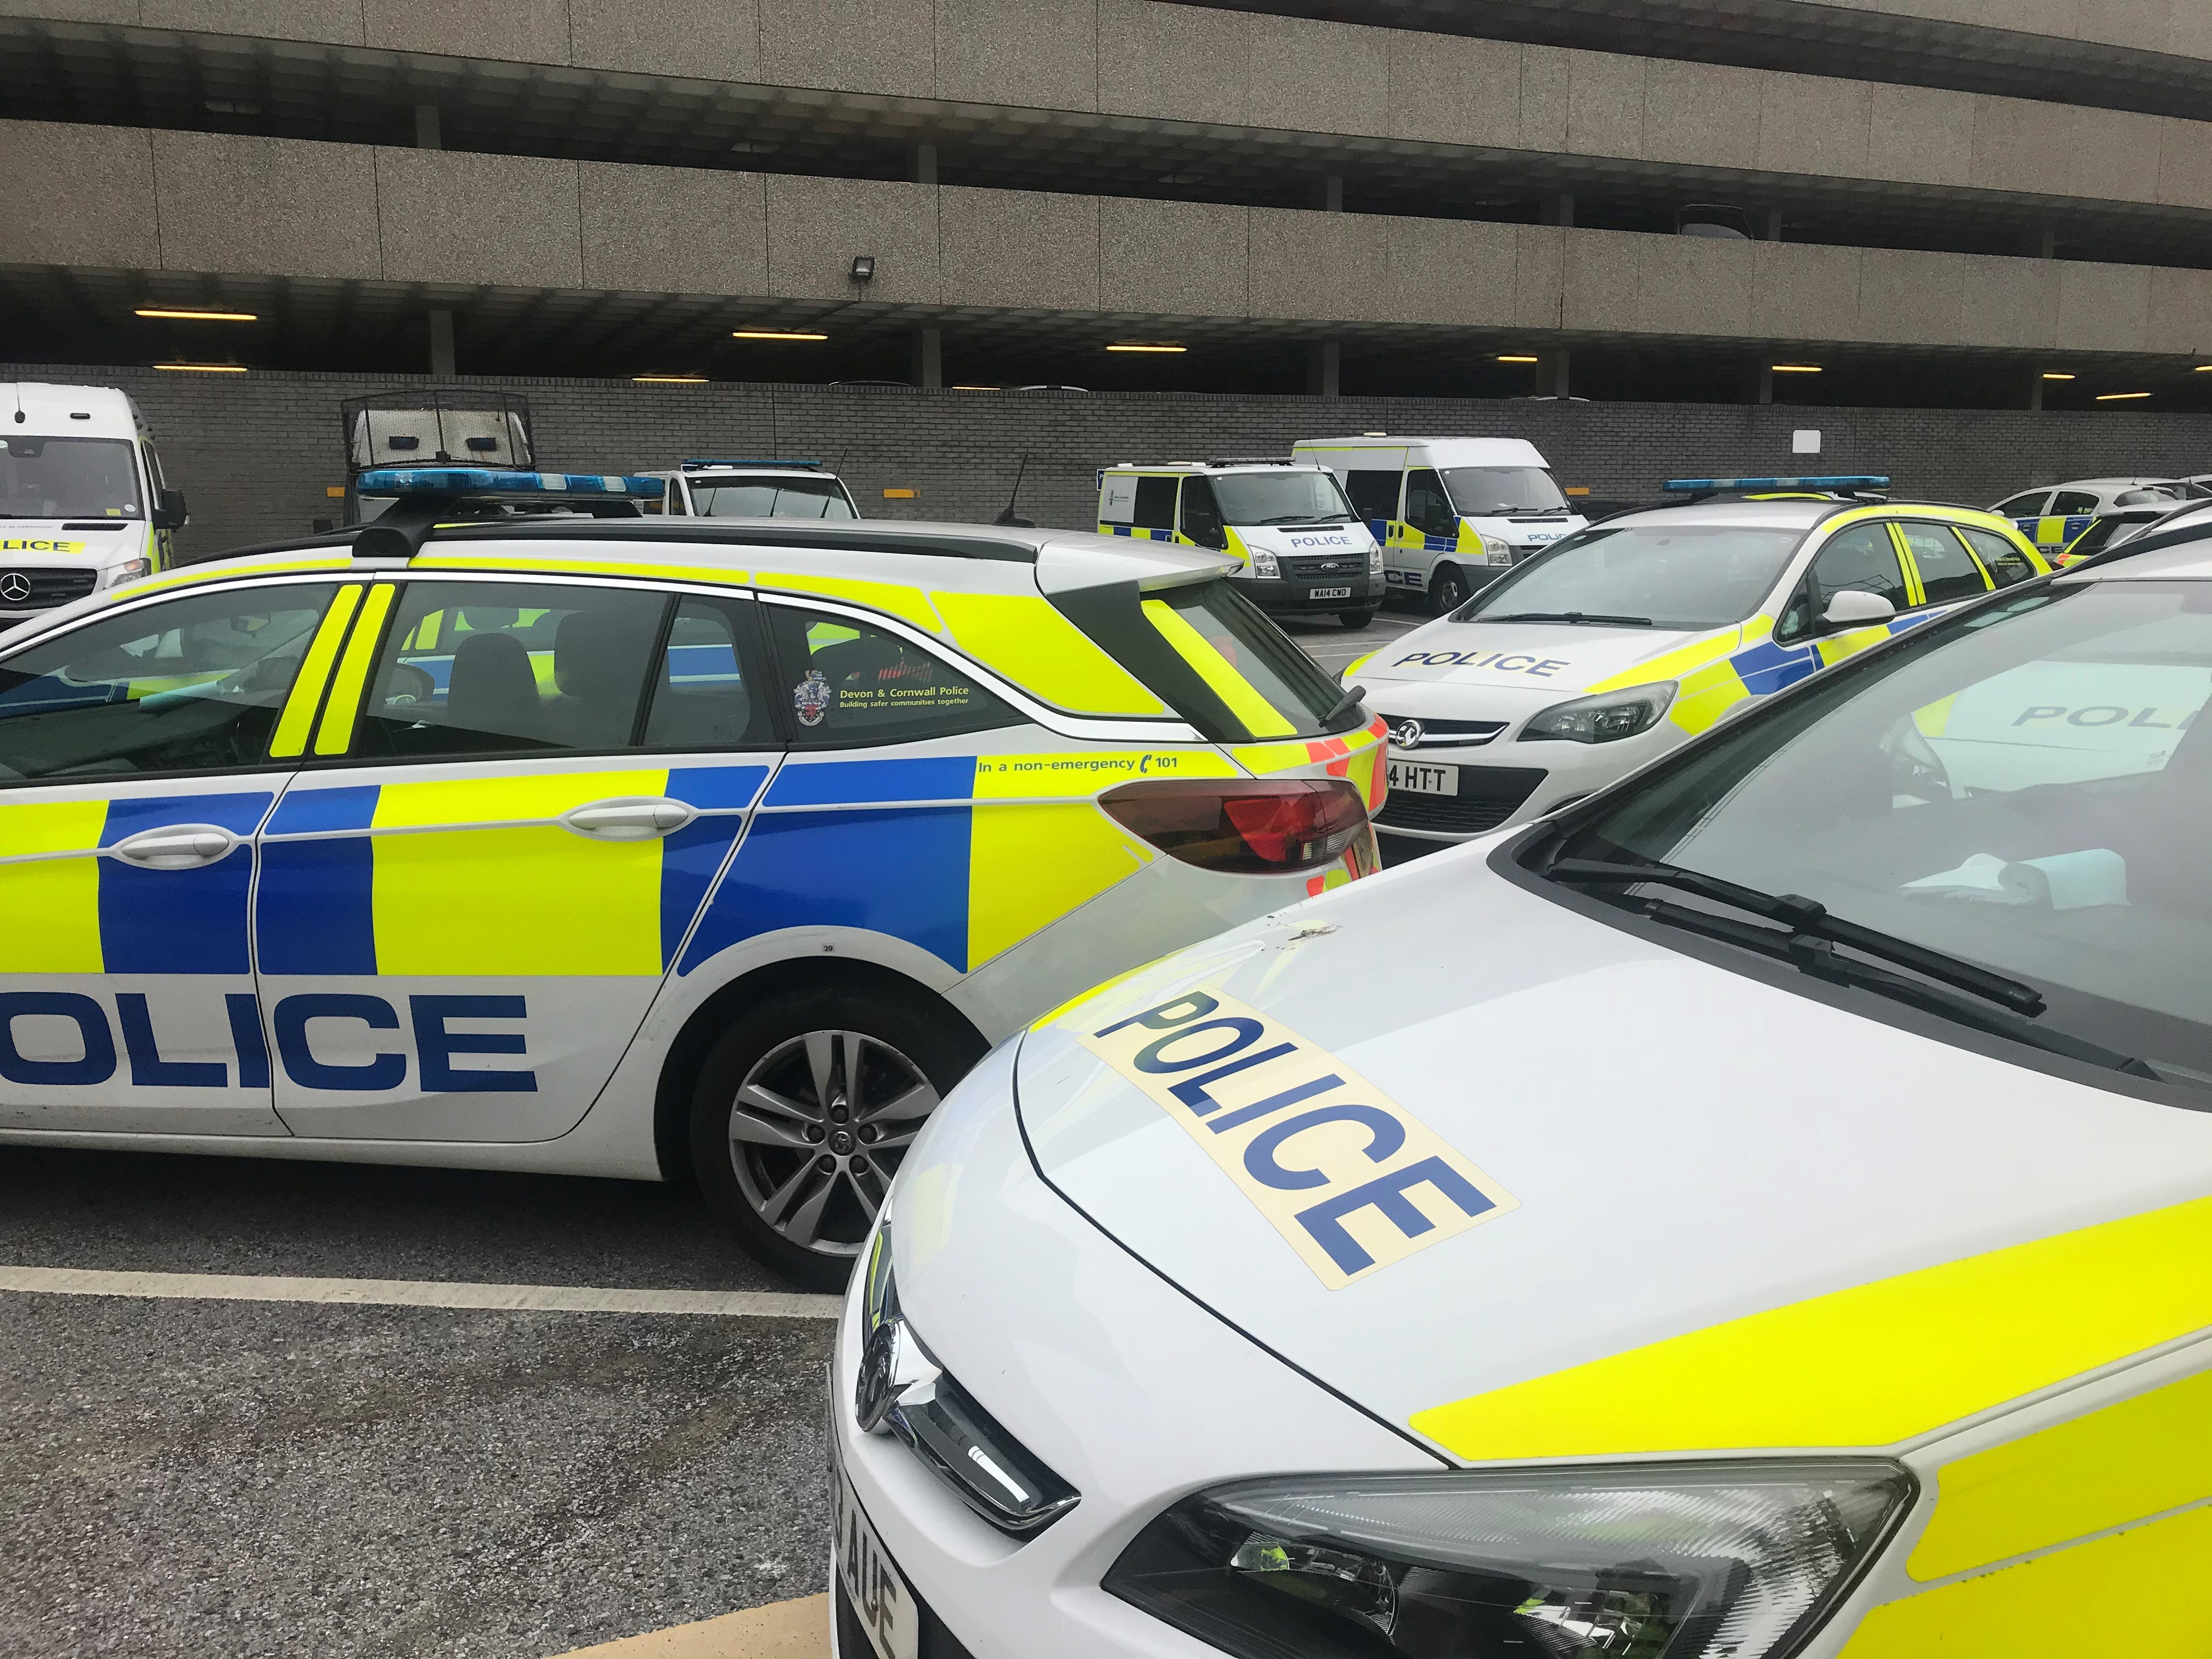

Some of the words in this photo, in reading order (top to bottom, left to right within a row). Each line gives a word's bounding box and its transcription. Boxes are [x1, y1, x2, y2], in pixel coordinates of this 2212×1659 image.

[3, 540, 70, 552] LICE
[1291, 536, 1352, 548] POLICE
[1314, 589, 1330, 597] WA14
[1391, 652, 1571, 678] POLICE
[840, 690, 873, 698] Devon
[877, 689, 885, 697] &
[890, 687, 936, 697] Cornwall
[940, 686, 969, 696] Police
[937, 697, 969, 706] together
[979, 763, 991, 772] In
[999, 763, 1007, 771] a
[1014, 760, 1135, 771] non-emergency
[1155, 757, 1177, 768] 101
[1405, 766, 1446, 791] HTT
[0, 991, 538, 1092] OLICE
[1092, 991, 1497, 1276] POLICE
